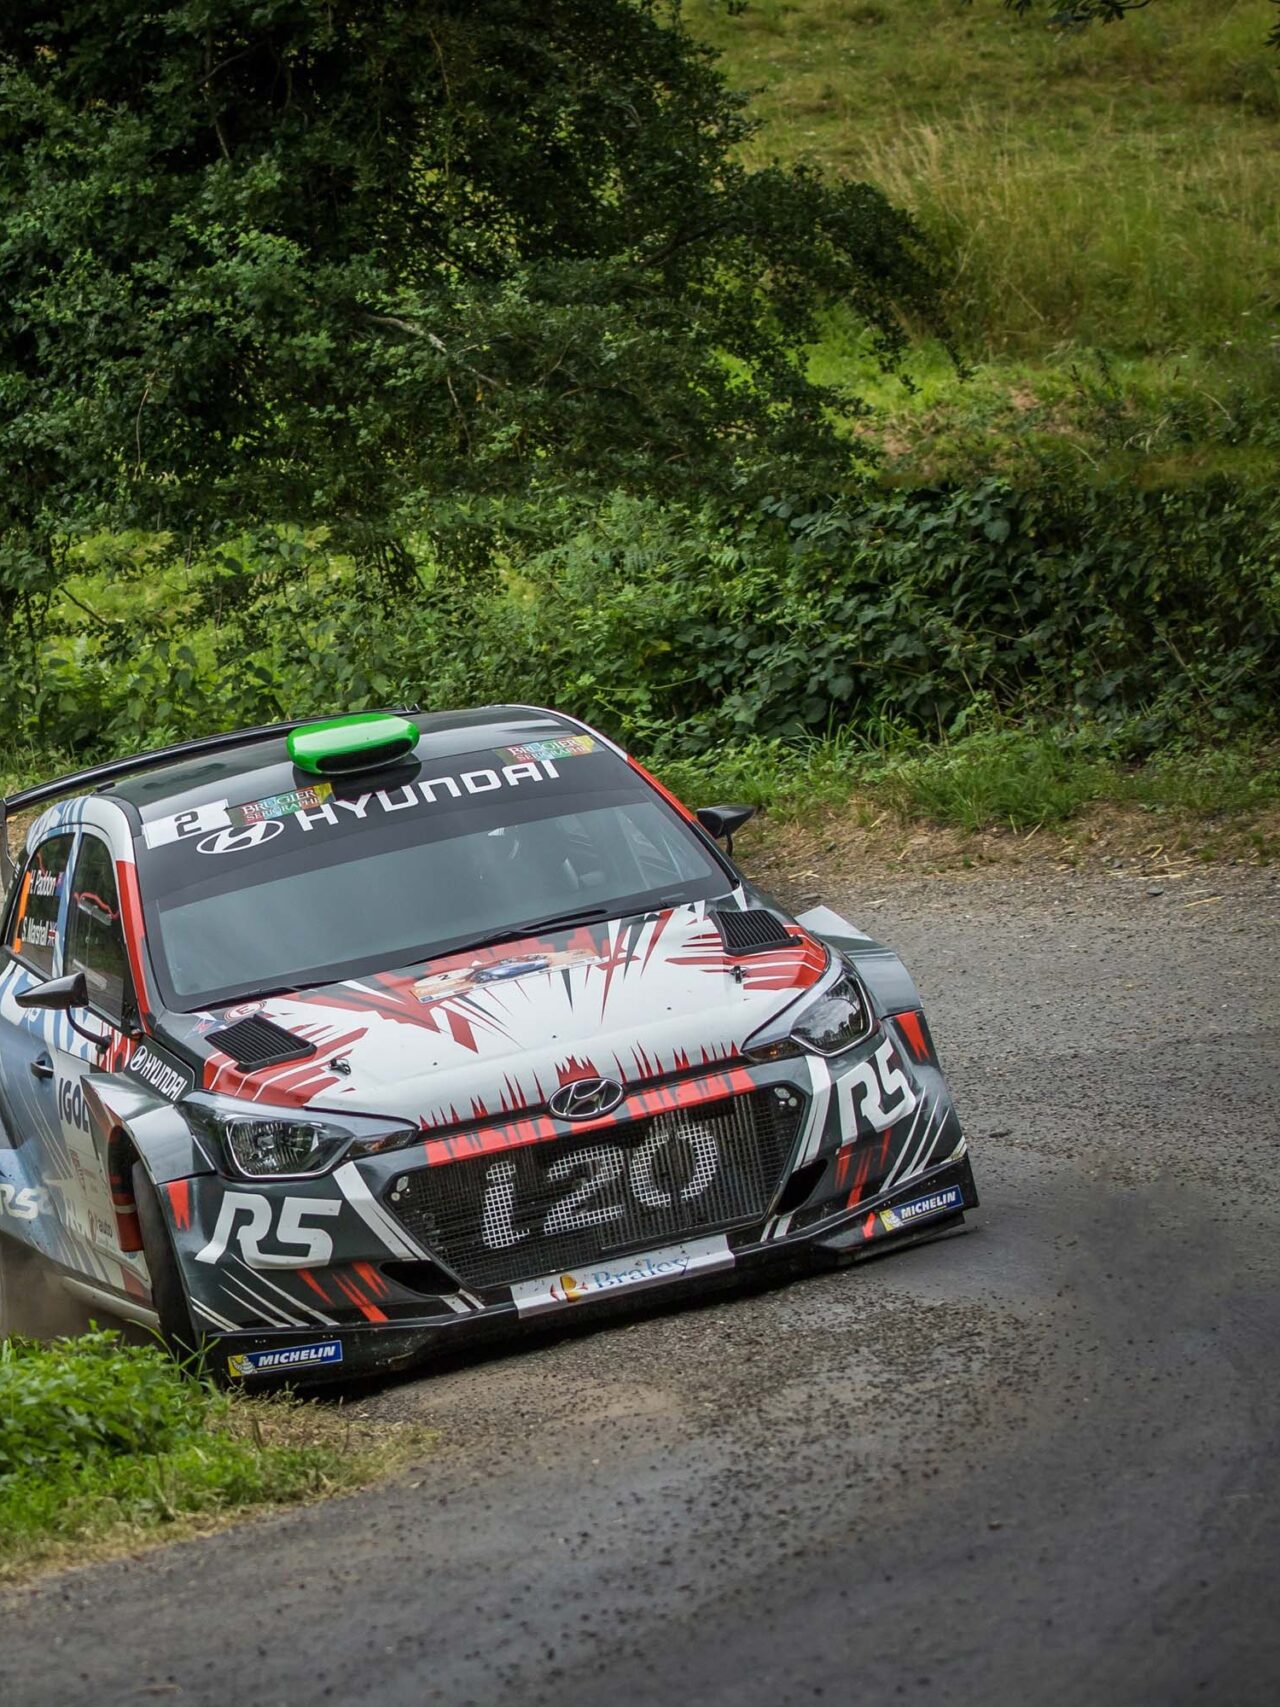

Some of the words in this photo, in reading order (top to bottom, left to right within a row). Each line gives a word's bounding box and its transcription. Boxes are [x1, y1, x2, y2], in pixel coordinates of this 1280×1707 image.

[241, 790, 317, 815] BRUGIER
[294, 759, 560, 832] HYUNDAI
[174, 810, 202, 838] 2
[26, 917, 50, 946] Marshall
[140, 1053, 188, 1101] HYUNDAI
[836, 1036, 917, 1148] R5
[900, 1191, 957, 1219] MICHELIN
[194, 1190, 343, 1270] R5
[257, 1345, 336, 1367] MICHELIN
